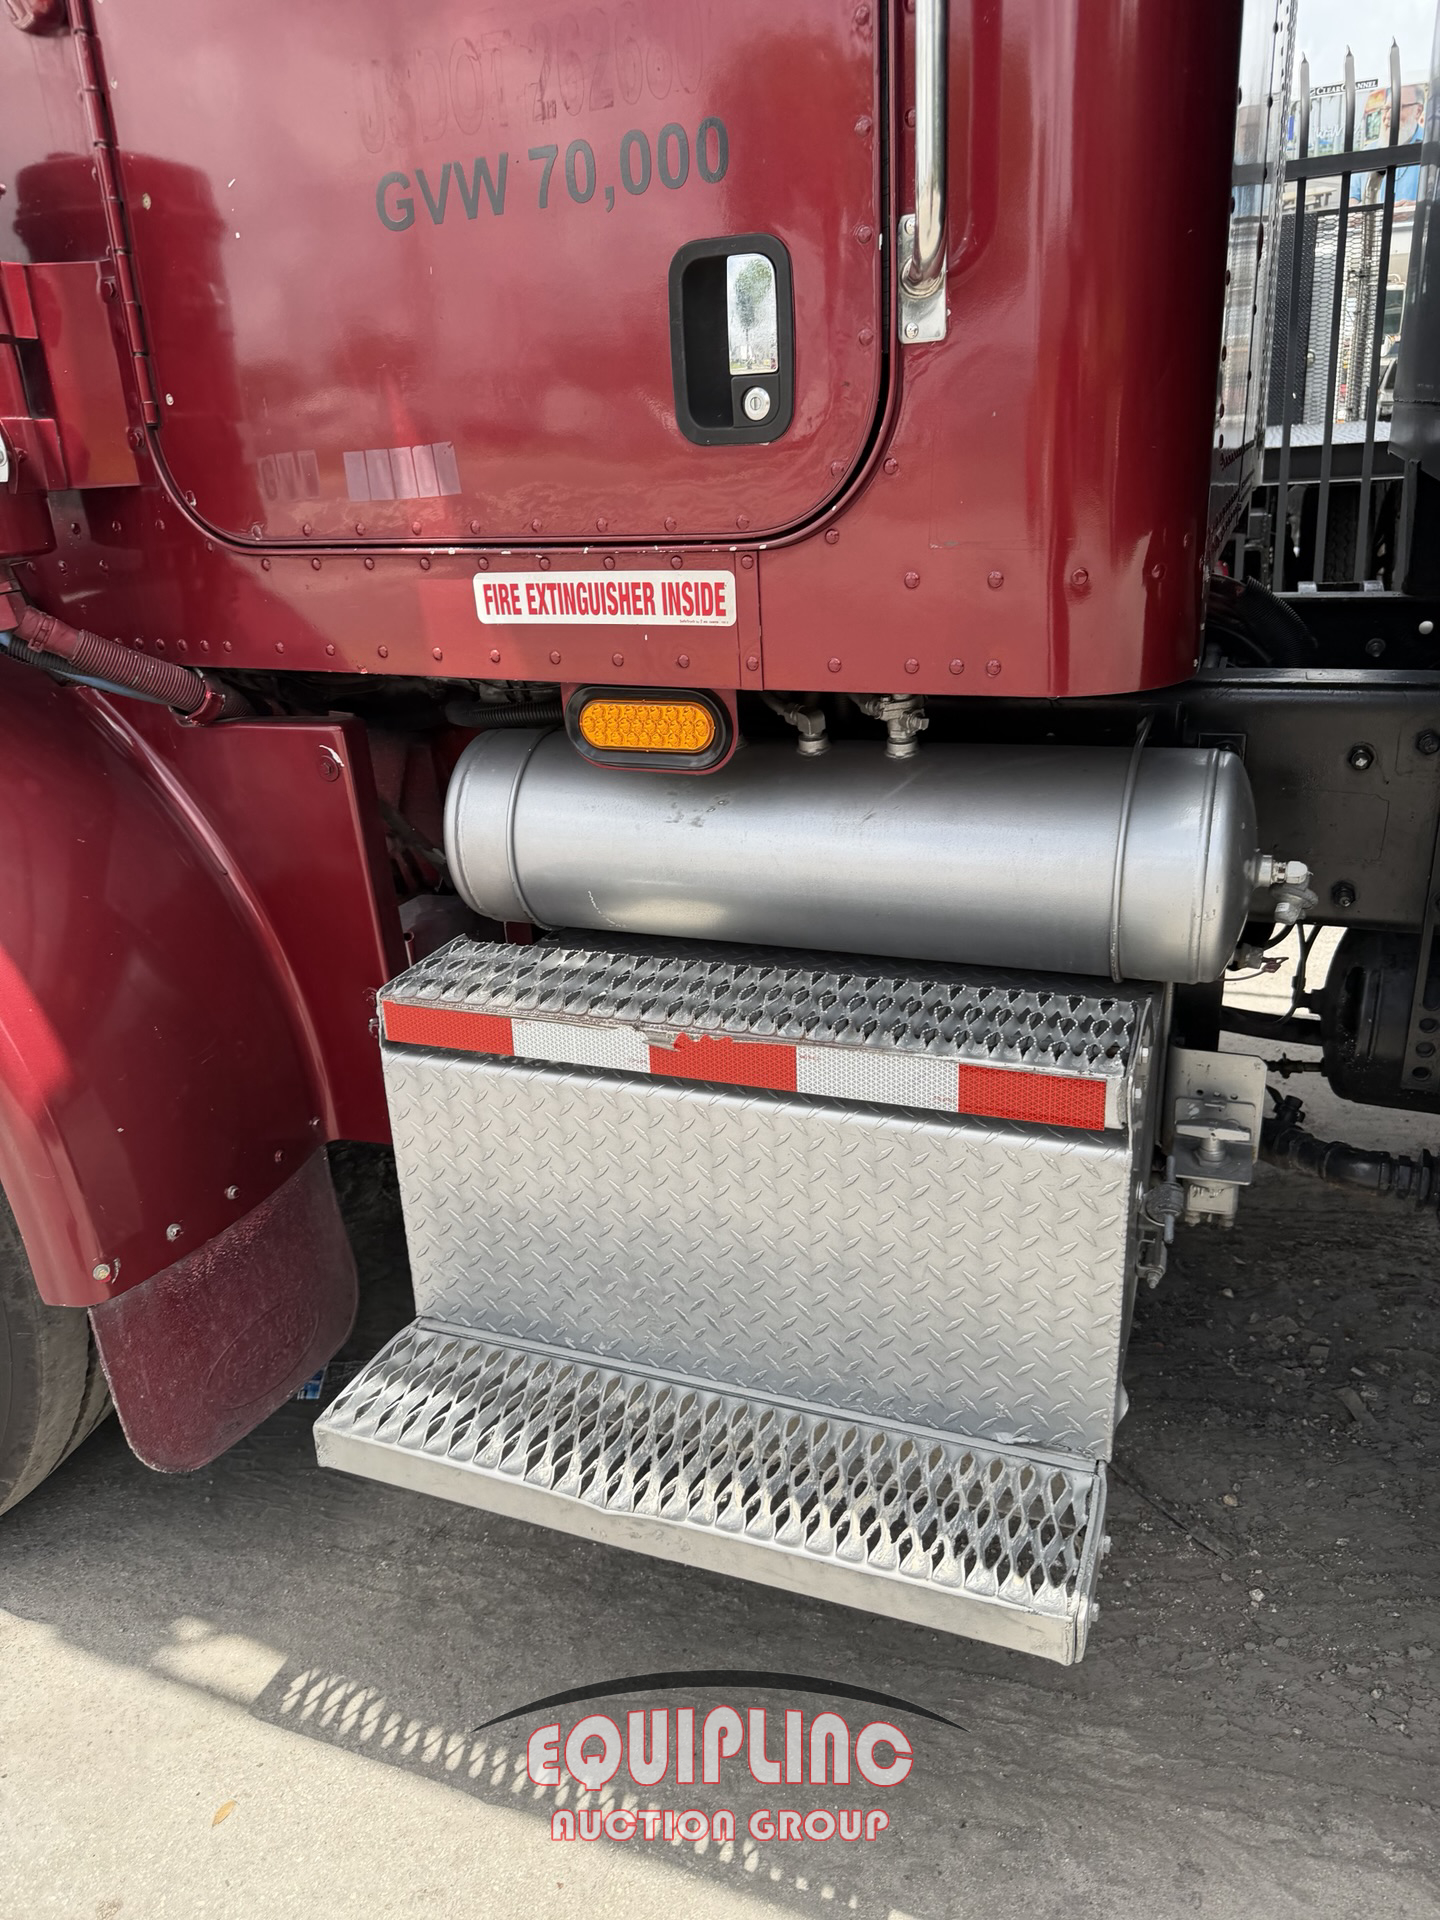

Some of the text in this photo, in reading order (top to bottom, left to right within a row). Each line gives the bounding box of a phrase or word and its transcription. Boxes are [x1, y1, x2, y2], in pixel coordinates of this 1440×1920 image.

[375, 116, 729, 232] GVW 70,000
[482, 581, 727, 617] FIRE EXTINGUISHER INSIDE
